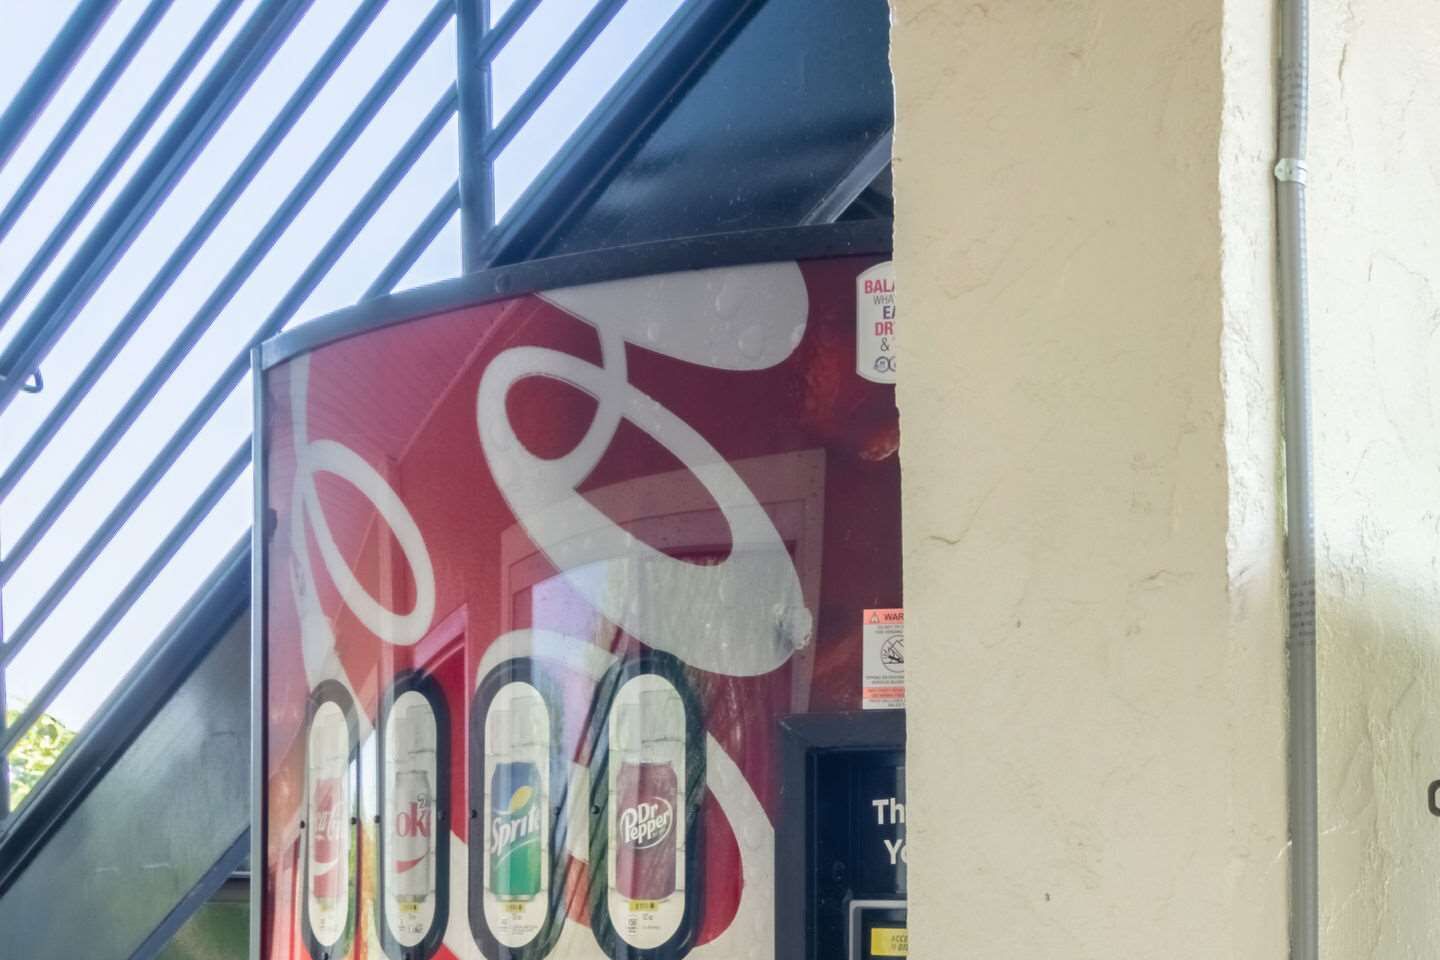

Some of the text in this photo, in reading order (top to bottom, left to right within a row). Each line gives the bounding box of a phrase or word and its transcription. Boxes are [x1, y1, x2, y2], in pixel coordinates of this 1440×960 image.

[873, 296, 895, 304] WHA
[875, 322, 894, 336] DR
[639, 803, 658, 819] Dr
[622, 807, 670, 844] Pepper
